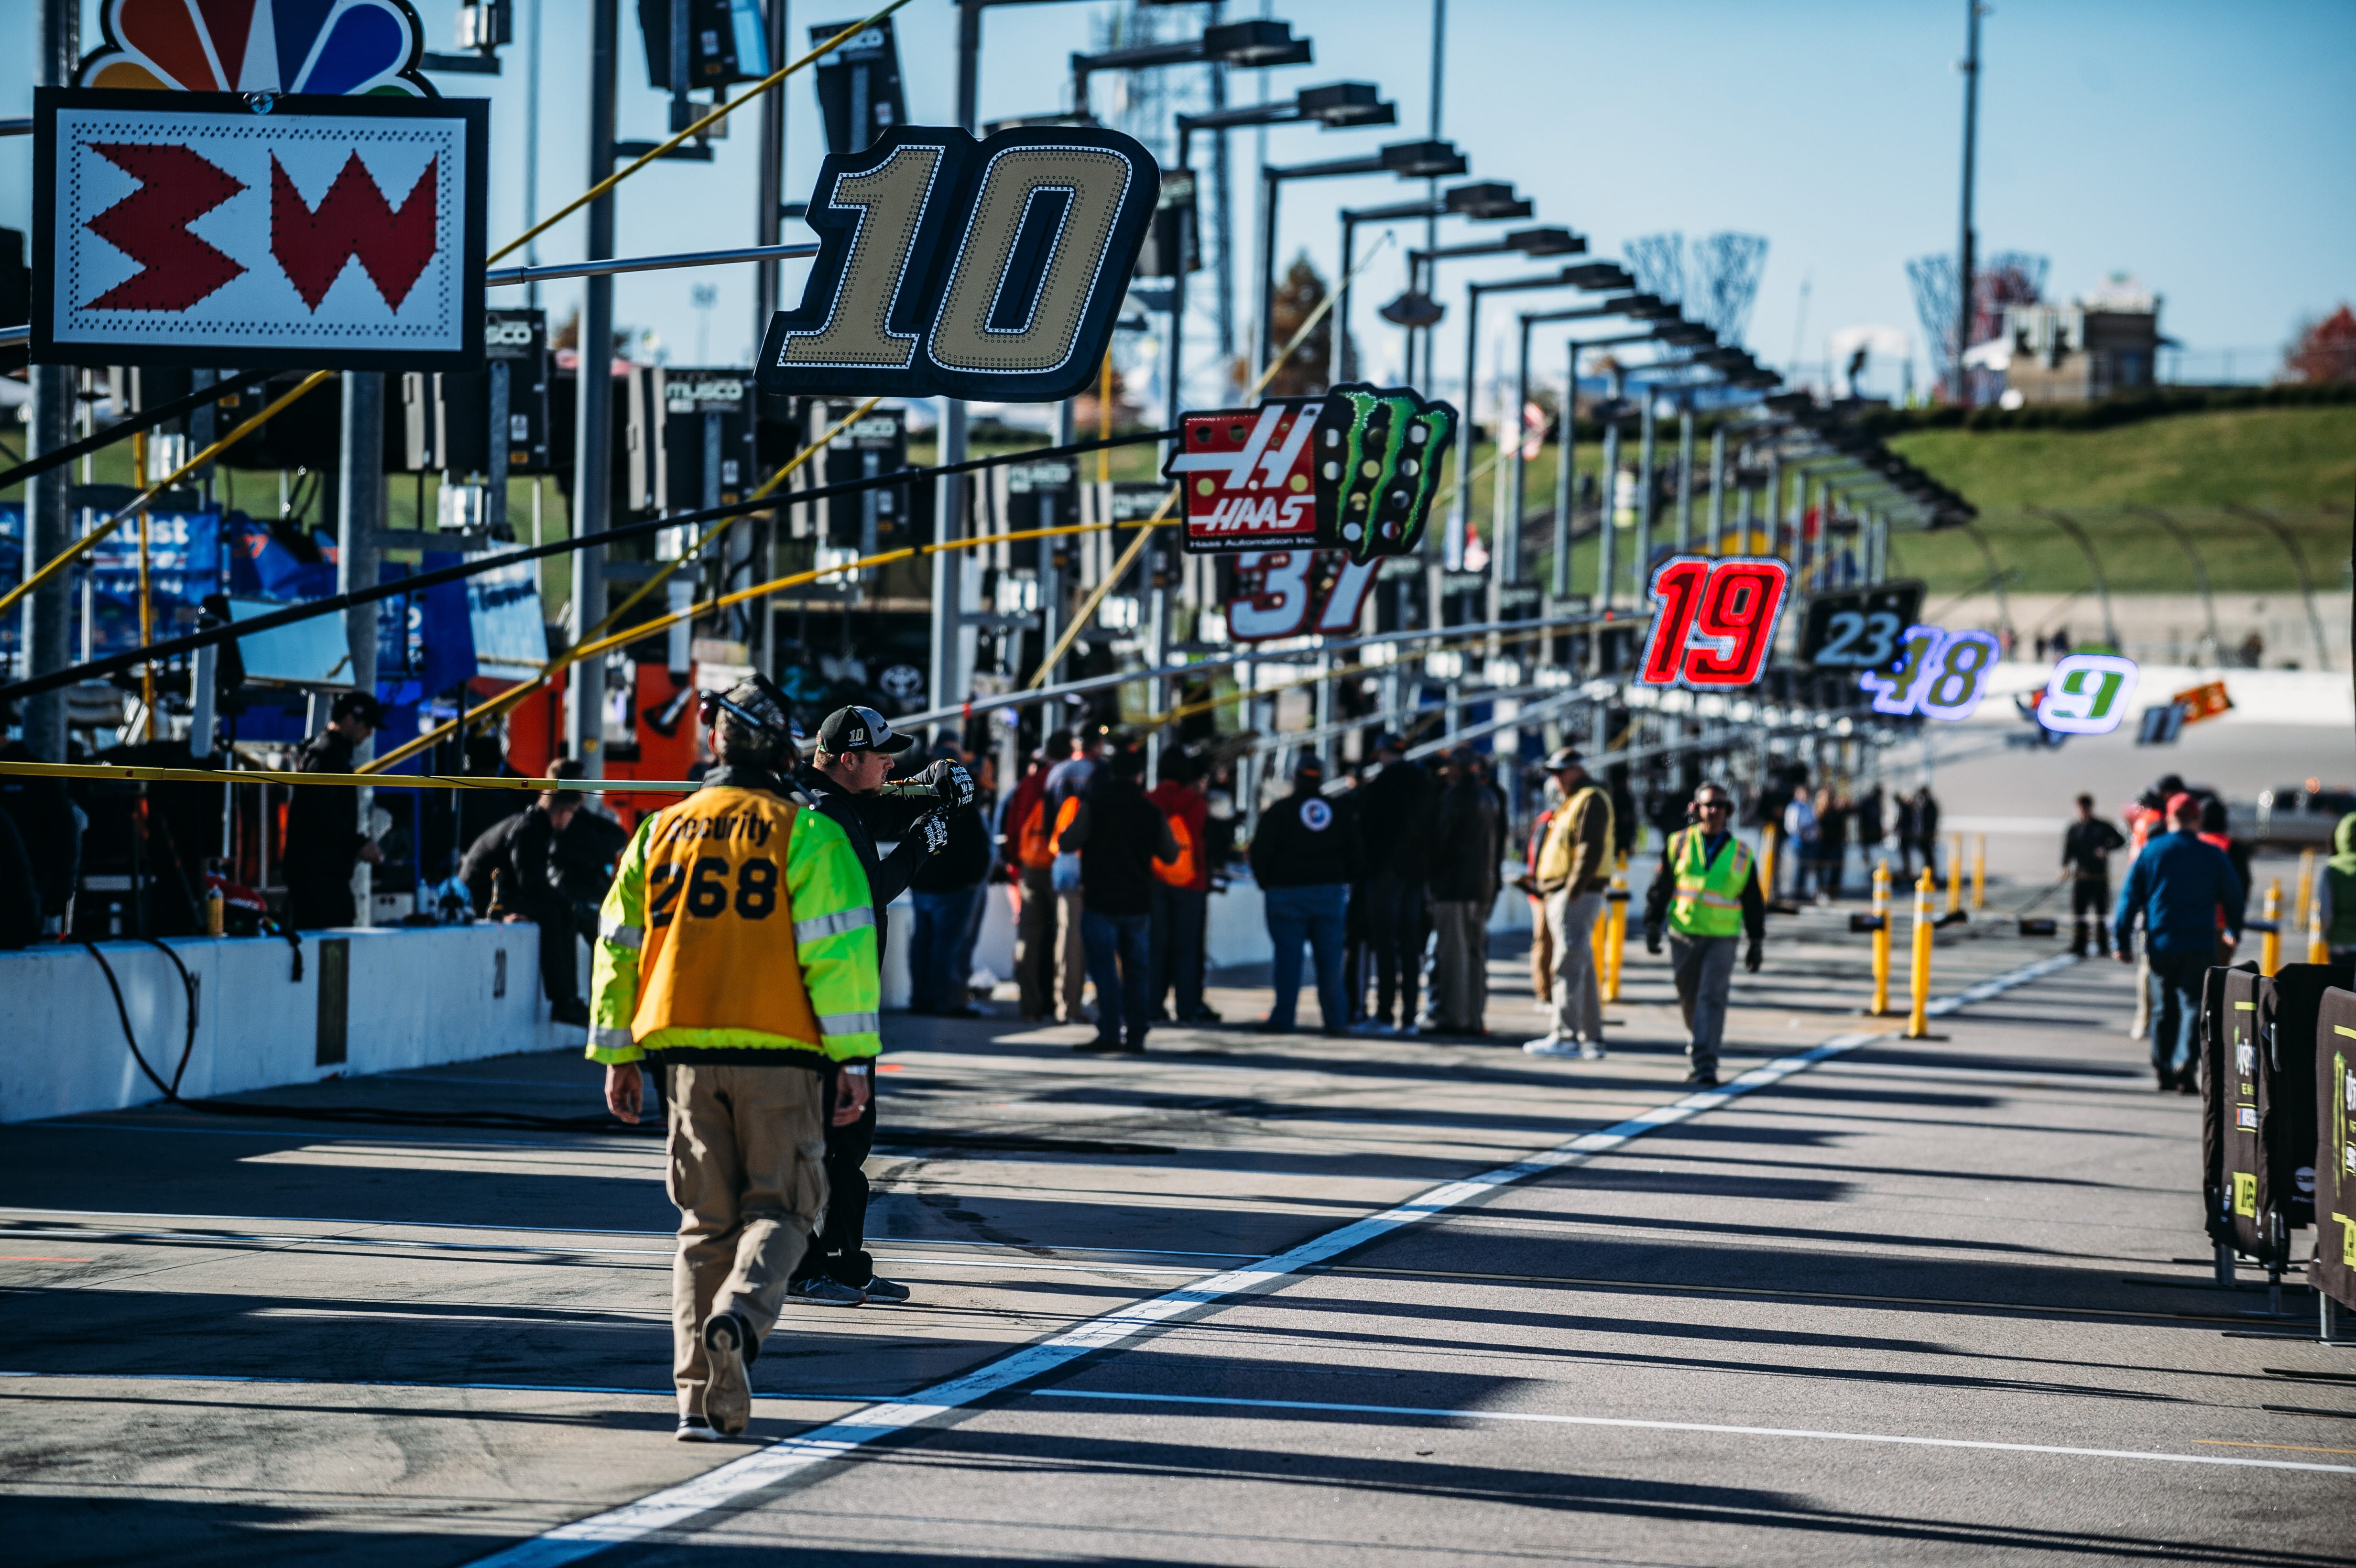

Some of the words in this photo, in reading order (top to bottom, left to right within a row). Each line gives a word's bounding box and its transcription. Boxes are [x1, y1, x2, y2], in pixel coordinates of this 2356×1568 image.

[776, 144, 1133, 374] 10
[1189, 495, 1316, 531] HAAS
[1189, 540, 1222, 548] Haas
[1224, 538, 1294, 547] Automation
[1637, 557, 1789, 688] 19
[1816, 611, 1900, 667] 23
[2044, 661, 2131, 727] 9
[849, 728, 863, 741] 10
[669, 810, 773, 847] Security
[650, 857, 778, 927] 268
